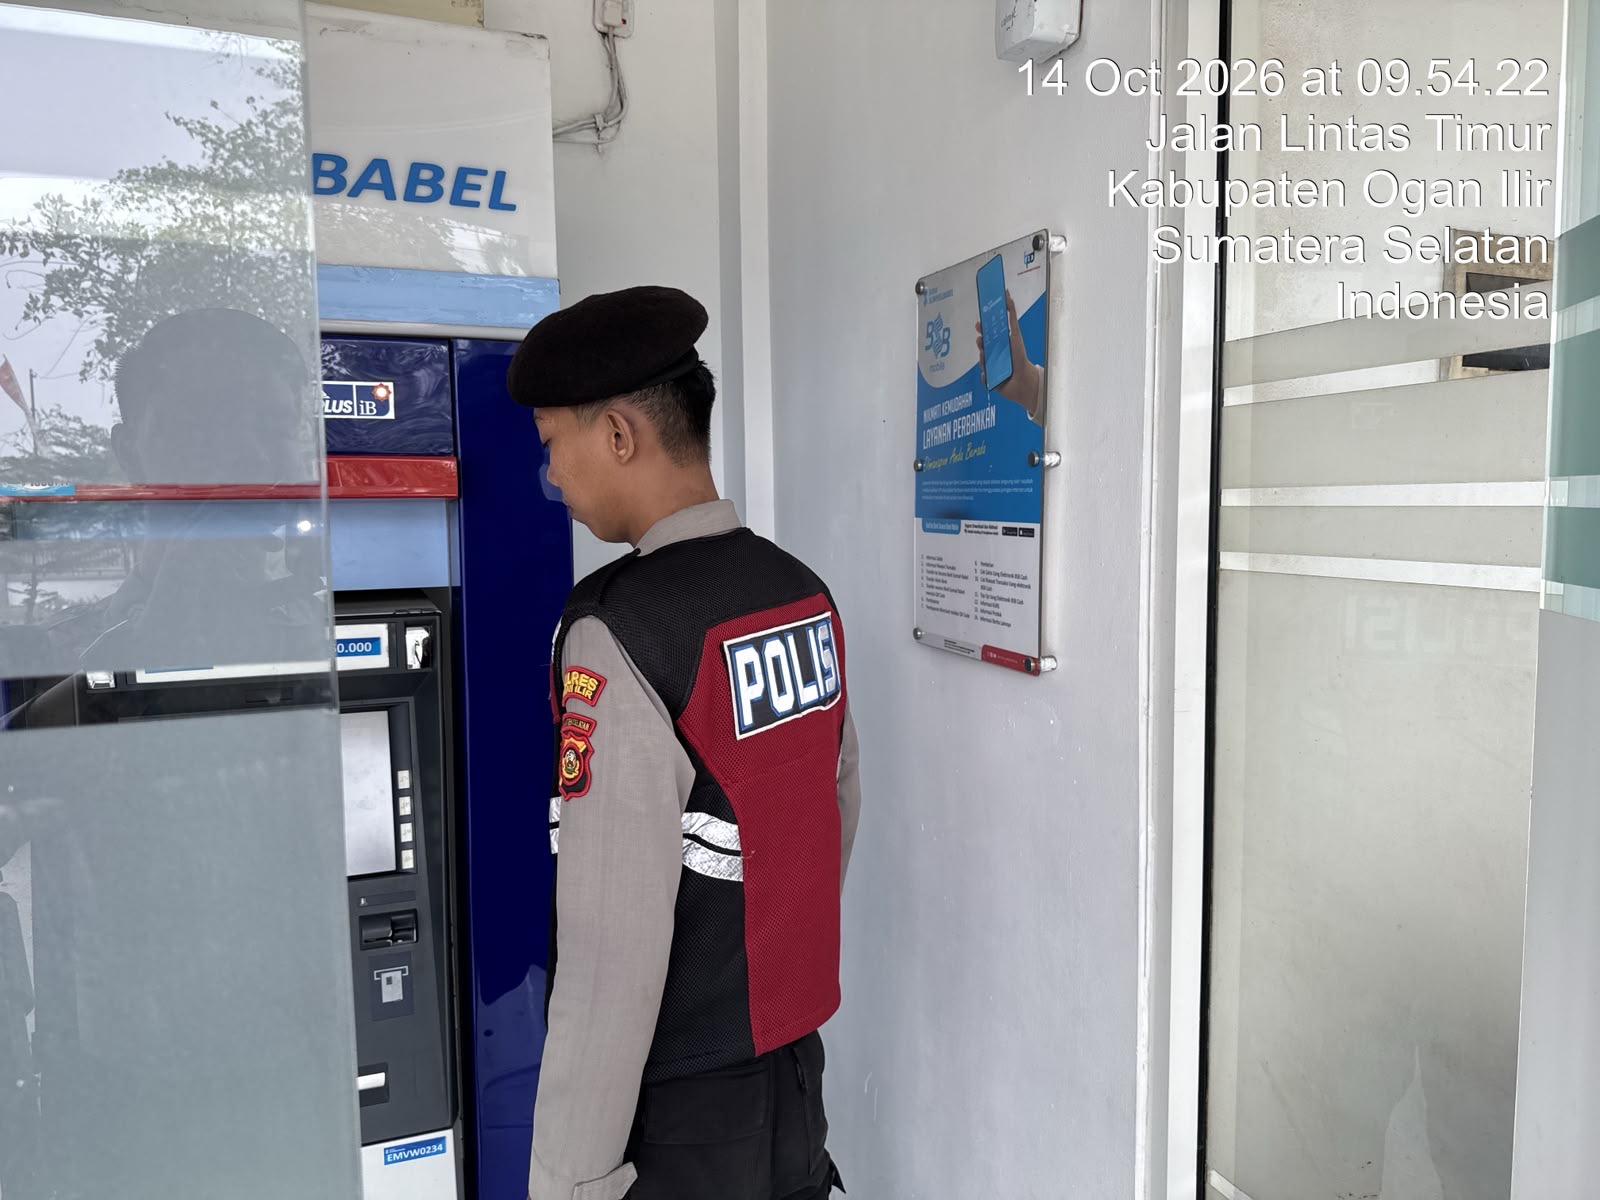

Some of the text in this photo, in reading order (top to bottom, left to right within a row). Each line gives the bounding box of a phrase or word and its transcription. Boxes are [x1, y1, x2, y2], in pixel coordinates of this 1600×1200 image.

[312, 153, 517, 211] BABEL
[322, 399, 377, 415] LUS iB
[942, 391, 973, 417] KEMUDAHAN
[923, 404, 996, 450] LAYANAN PERBANKAN
[336, 642, 372, 653] 0.000
[731, 619, 839, 730] POLIS
[387, 1143, 443, 1162] EMVW0234
